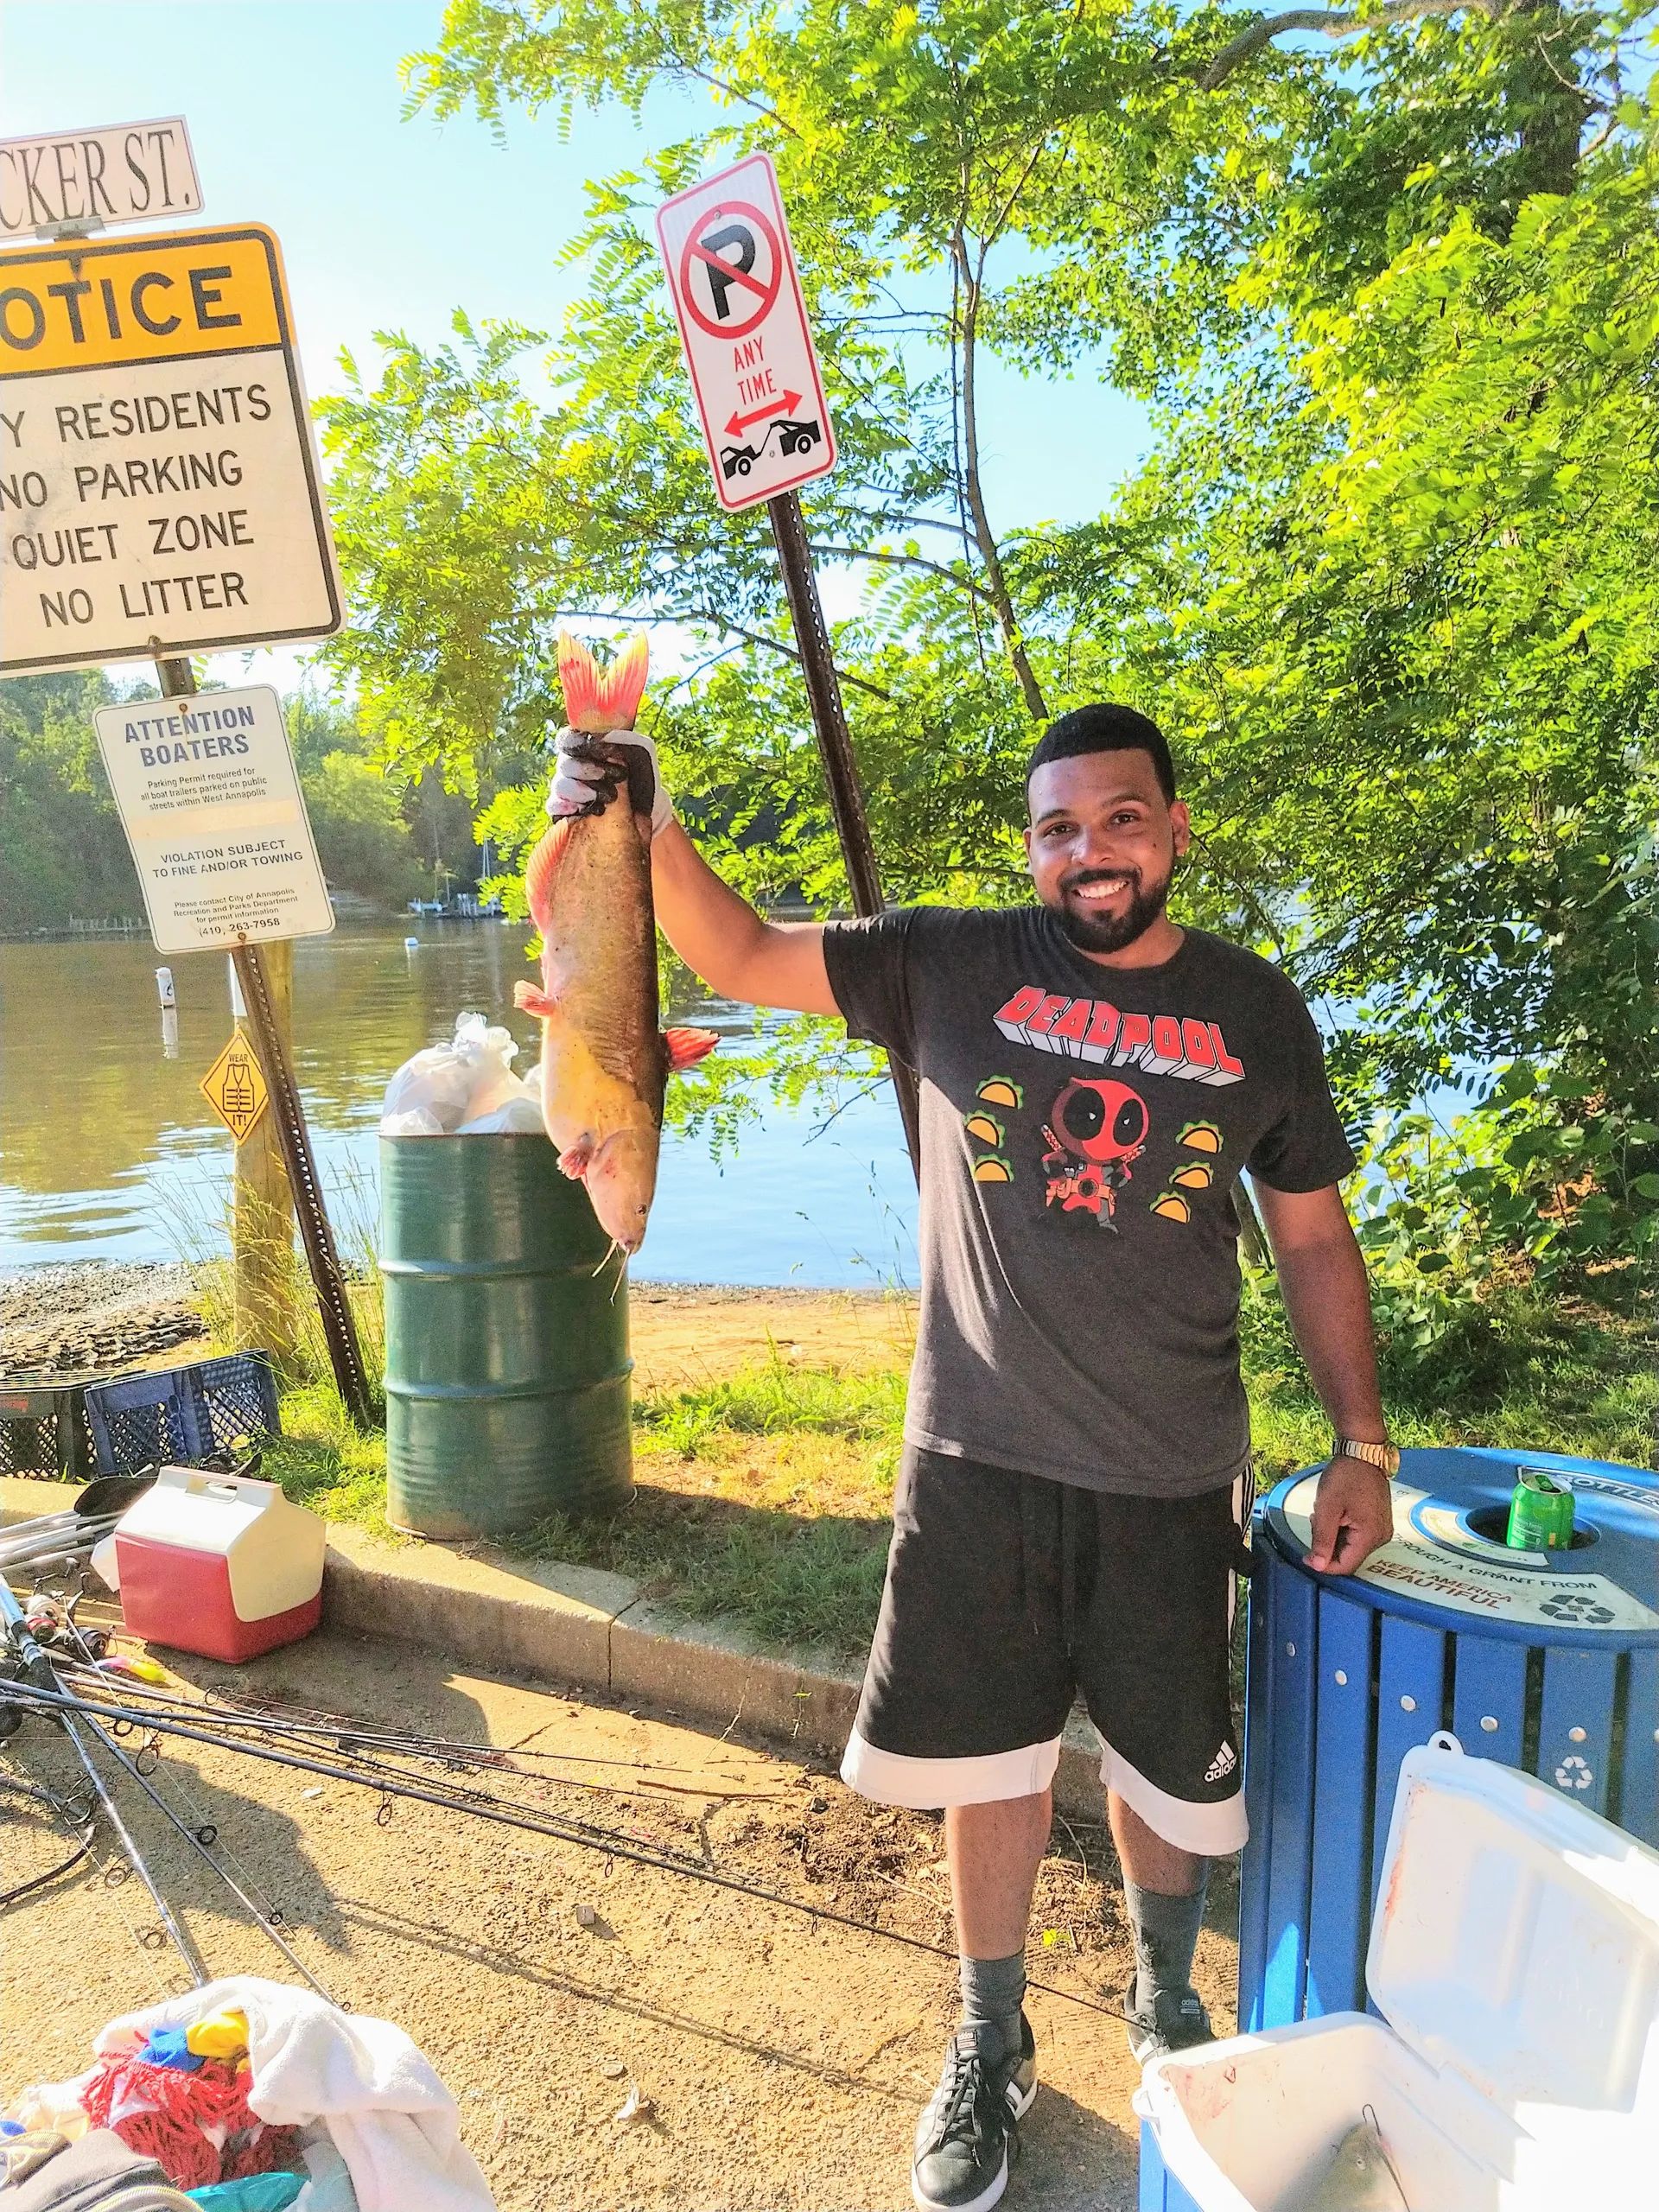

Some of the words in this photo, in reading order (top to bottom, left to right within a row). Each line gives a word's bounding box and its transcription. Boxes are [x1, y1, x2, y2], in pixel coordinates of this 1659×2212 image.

[0, 139, 118, 231] CKER
[124, 130, 190, 213] ST.
[0, 265, 242, 351] OTICE
[734, 335, 764, 372] ANY
[737, 368, 777, 405] TIME
[55, 385, 271, 442] RESIDENTS
[0, 472, 48, 512] NO
[74, 450, 243, 502] PARKING
[12, 524, 118, 570] QUIET
[148, 510, 254, 555] ZONE
[40, 588, 93, 627] NO
[119, 572, 249, 619] LITTER
[125, 706, 255, 743] ATTENTION
[140, 734, 250, 767] BOATERS
[140, 792, 150, 801] all
[150, 791, 168, 799] boat
[169, 786, 197, 797] trailers
[200, 782, 227, 794] parked
[242, 777, 268, 788] public
[148, 779, 178, 790] Parking
[179, 774, 207, 785] Permit
[207, 768, 242, 781] required
[243, 767, 256, 776] for
[149, 801, 175, 810] streets
[176, 797, 200, 807] within
[202, 794, 223, 804] West
[226, 788, 266, 800] Annapolis
[153, 868, 168, 878] TO
[171, 865, 197, 876] FINE
[200, 859, 248, 874] AND/OR
[251, 851, 303, 867] TOWING
[160, 849, 224, 863] VIOLATION
[227, 840, 285, 855] SUBJECT
[174, 908, 211, 917] Recreation
[229, 902, 251, 911] Parks
[253, 896, 298, 908] Department
[175, 900, 197, 909] Please
[199, 897, 226, 906] contact
[256, 888, 295, 899] Annapolis
[208, 914, 232, 924] permit
[234, 908, 279, 918] information
[229, 917, 281, 932] 263-7958
[993, 985, 1245, 1087] DEADPOOL
[229, 1053, 248, 1063] WEAR
[232, 1115, 247, 1126] IT!
[1392, 1533, 1452, 1565] THROUGH
[1469, 1568, 1535, 1585] GRANT
[1541, 1580, 1598, 1589] FROM
[1366, 1565, 1500, 1609] BEAUTIFUL
[1376, 1559, 1426, 1575] KEEP
[1426, 1575, 1512, 1603] AMERICA
